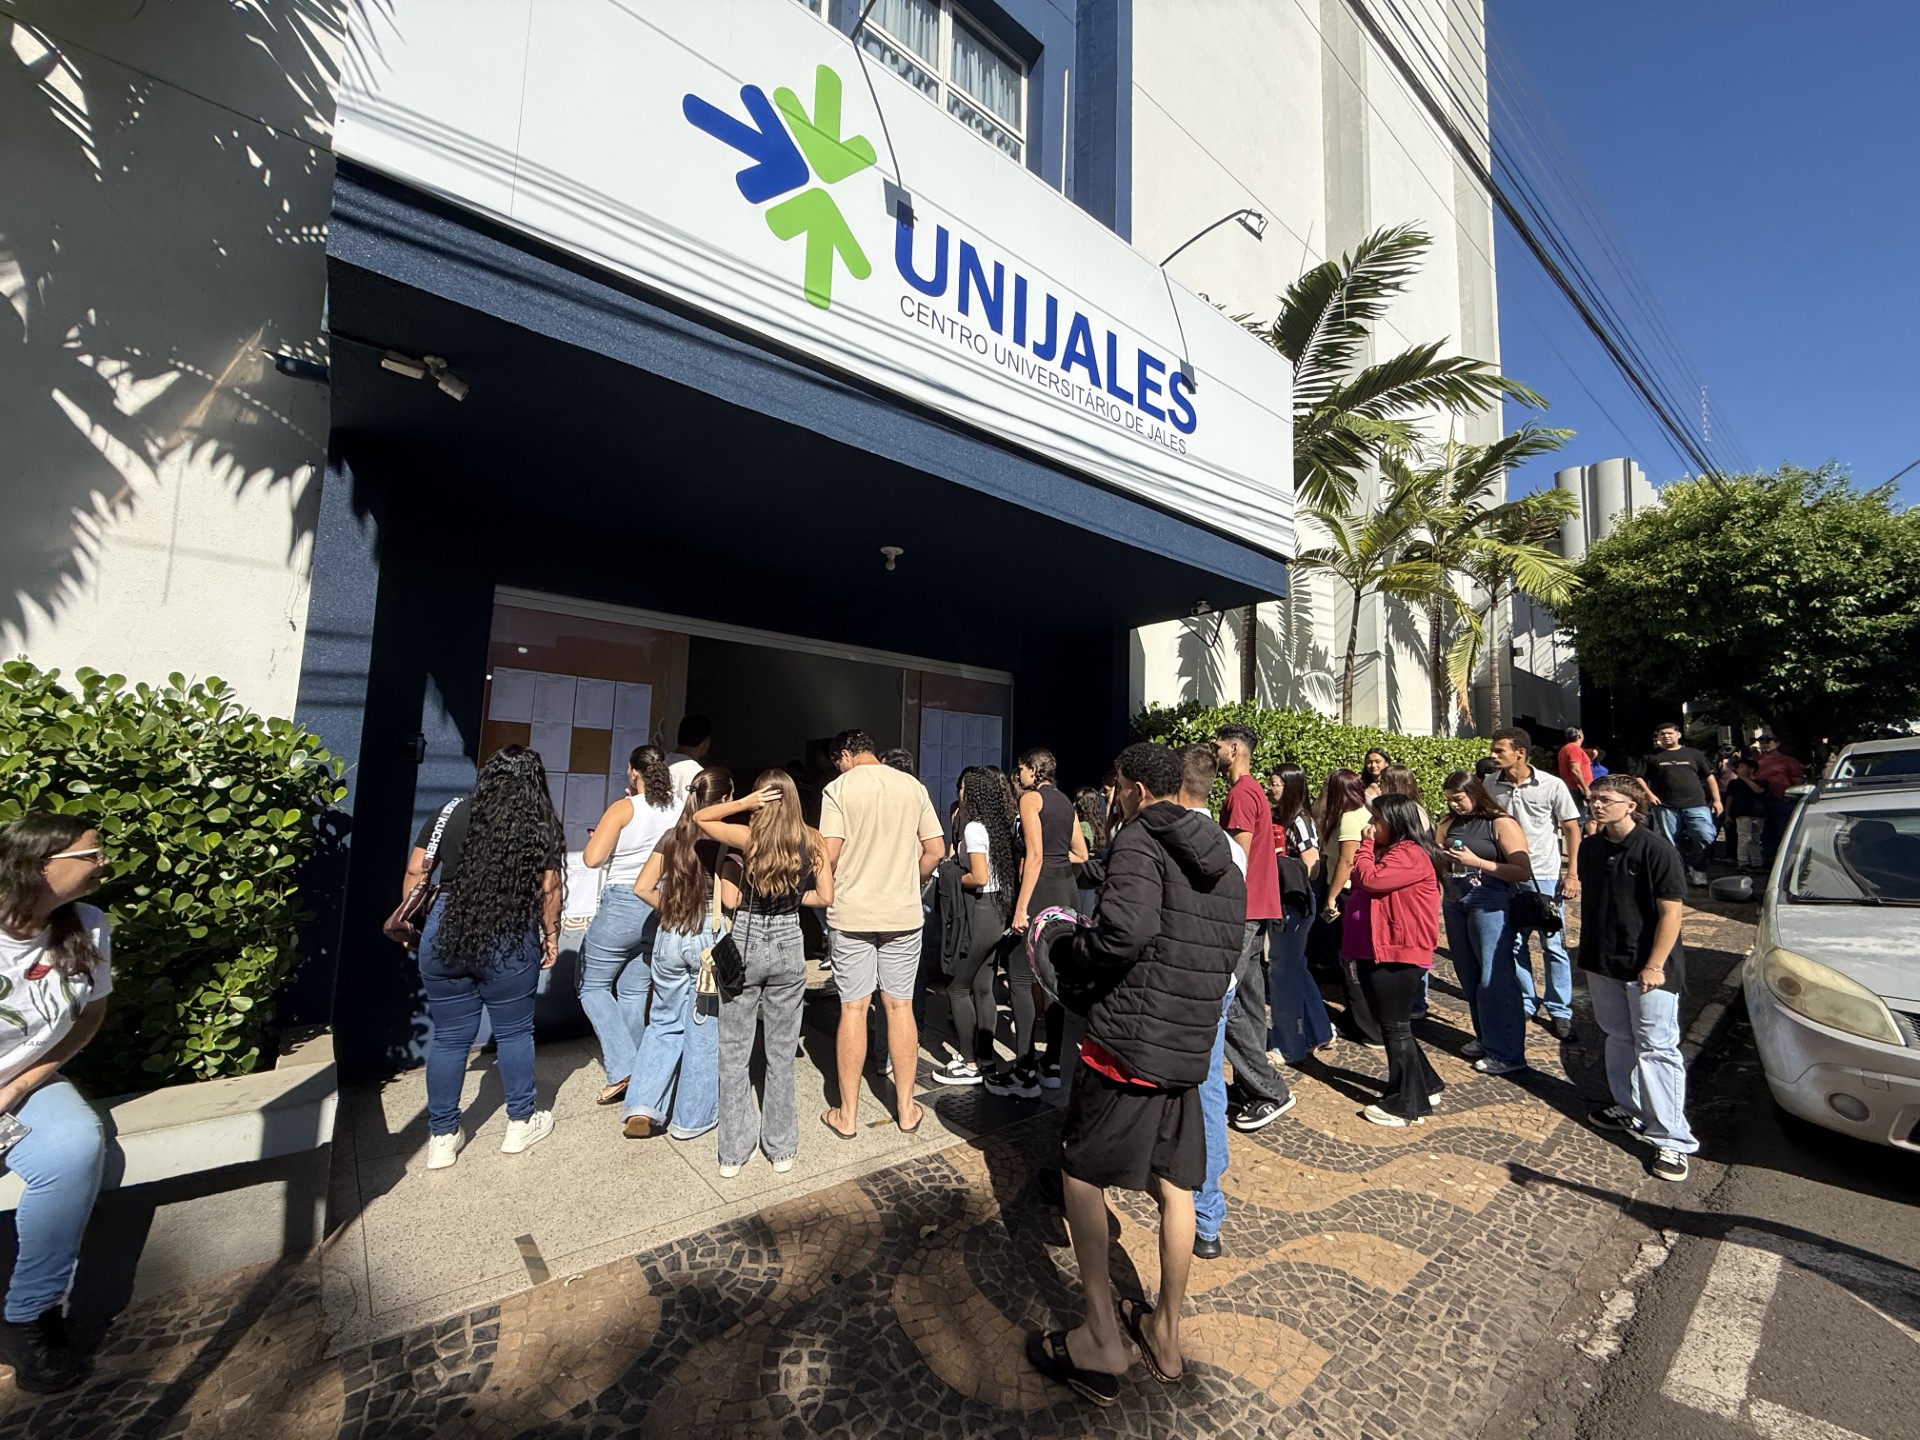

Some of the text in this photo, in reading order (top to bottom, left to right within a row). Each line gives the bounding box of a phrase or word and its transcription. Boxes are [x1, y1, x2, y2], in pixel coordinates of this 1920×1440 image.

[894, 199, 1197, 435] UNIJALES
[900, 295, 1187, 455] CENTRO UNIVERSITÁRIO DE JALES
[424, 816, 448, 859] KUCHEN
